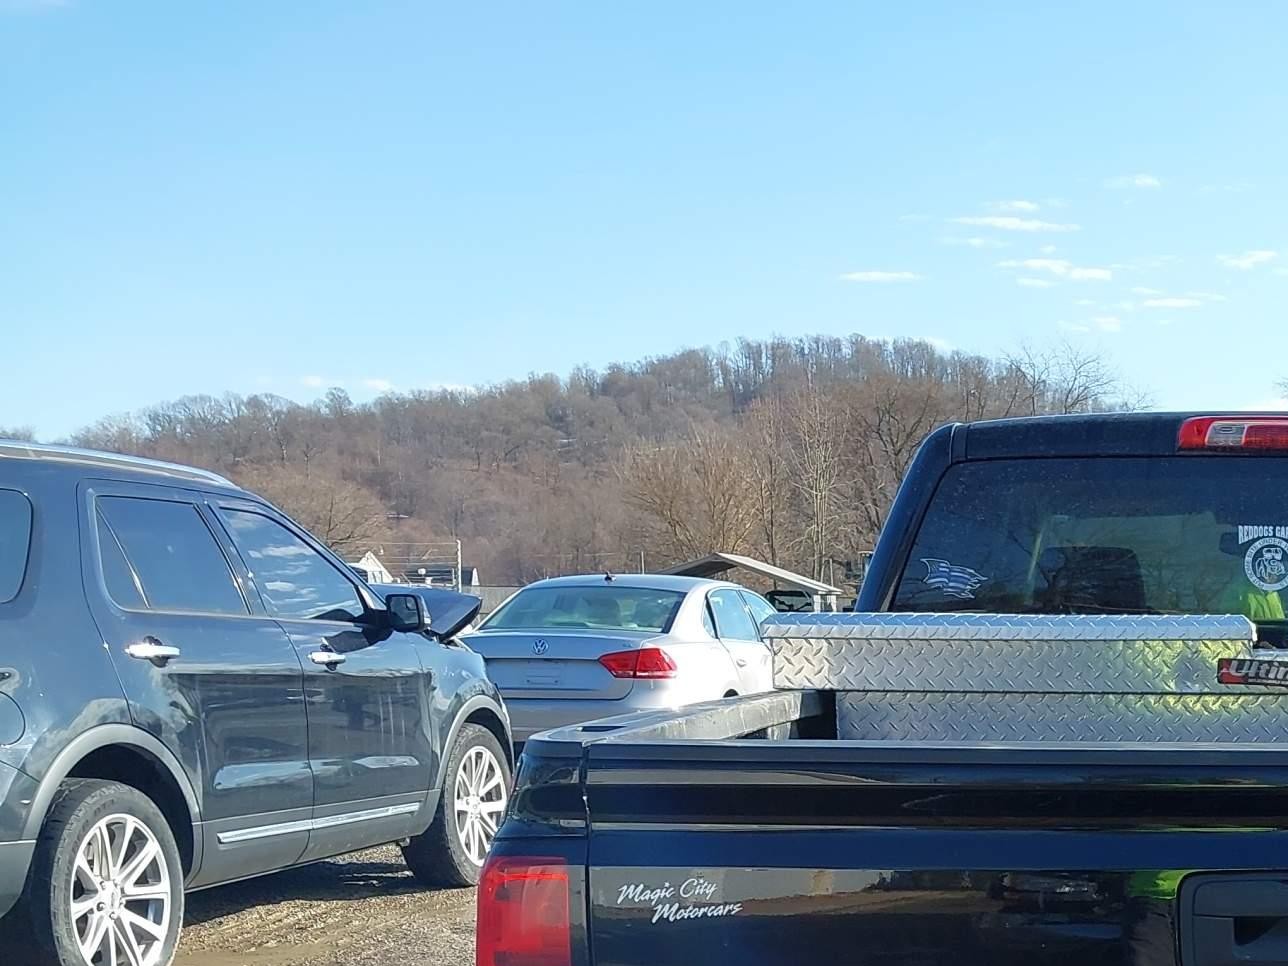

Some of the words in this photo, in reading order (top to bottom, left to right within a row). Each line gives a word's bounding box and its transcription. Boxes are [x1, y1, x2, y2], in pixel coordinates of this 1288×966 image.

[1238, 525, 1274, 545] REDDOGS
[617, 882, 676, 905] Magic
[680, 878, 718, 900] City
[652, 902, 743, 923] Motorcars
